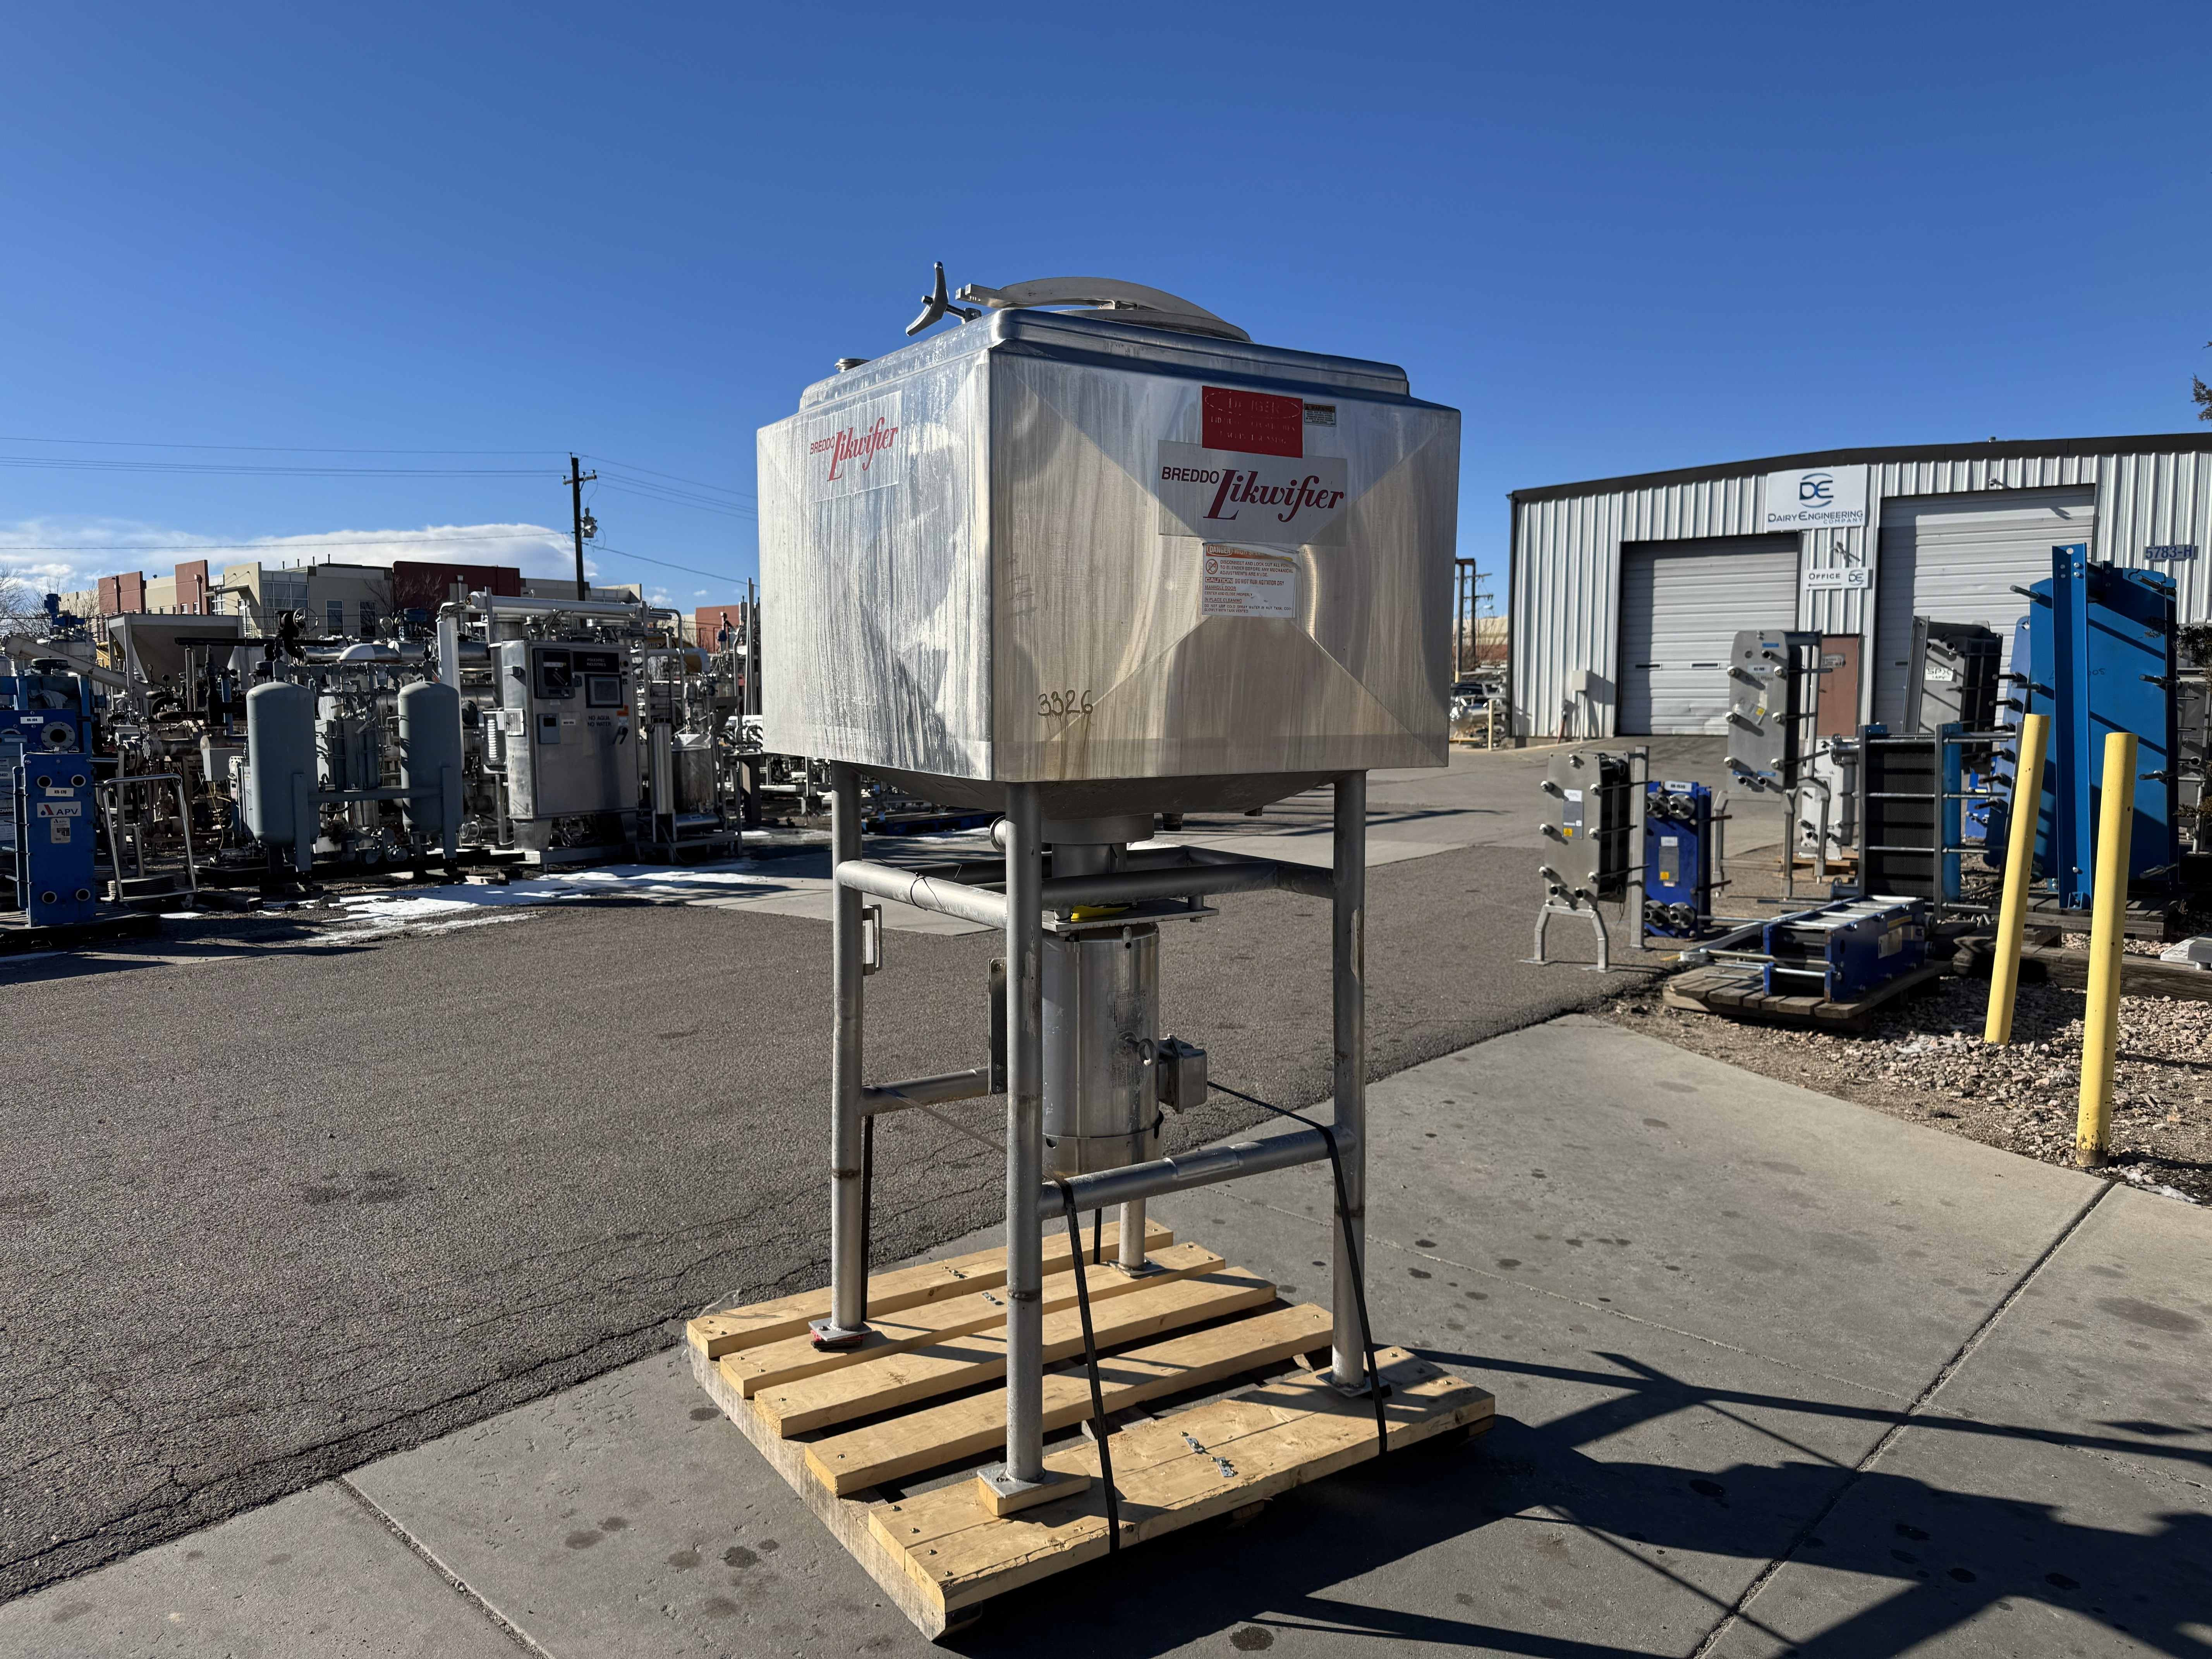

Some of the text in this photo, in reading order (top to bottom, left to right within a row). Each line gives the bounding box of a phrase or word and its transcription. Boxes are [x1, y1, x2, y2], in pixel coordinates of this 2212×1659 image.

[810, 417, 898, 481] BREDDO Likwifier
[1161, 466, 1344, 522] BREDDO Likwifier
[1768, 510, 1863, 522] DAIRY ENGINEERING
[1209, 546, 1230, 554] DANGER
[2145, 545, 2192, 559] 5783-H
[1037, 690, 1094, 716] 3326
